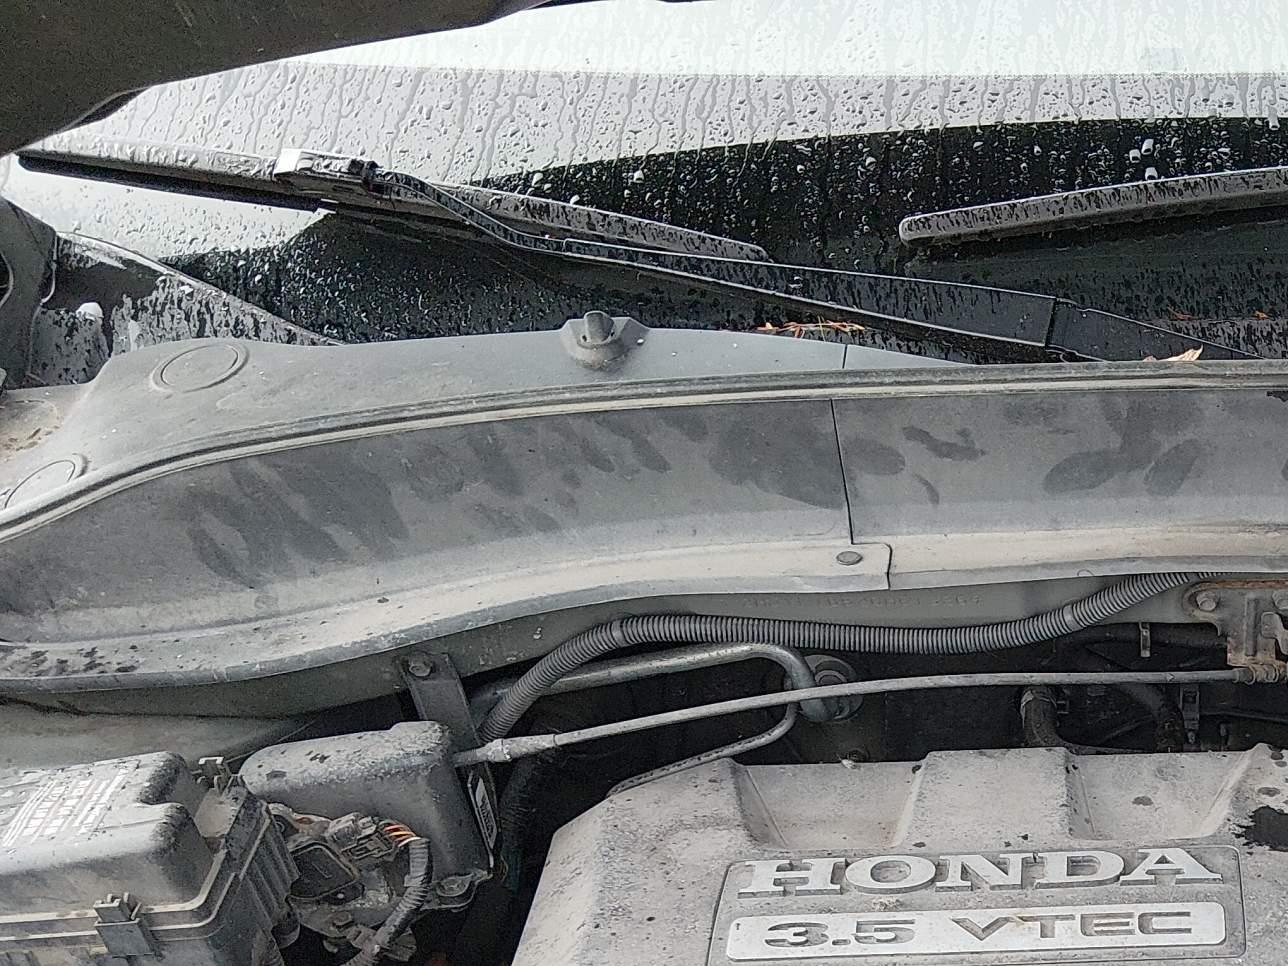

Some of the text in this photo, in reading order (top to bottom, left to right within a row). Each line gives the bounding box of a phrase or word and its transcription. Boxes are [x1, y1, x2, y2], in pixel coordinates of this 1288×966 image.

[738, 847, 1224, 898] HONDA
[765, 911, 1192, 948] 3.5 VTEC
